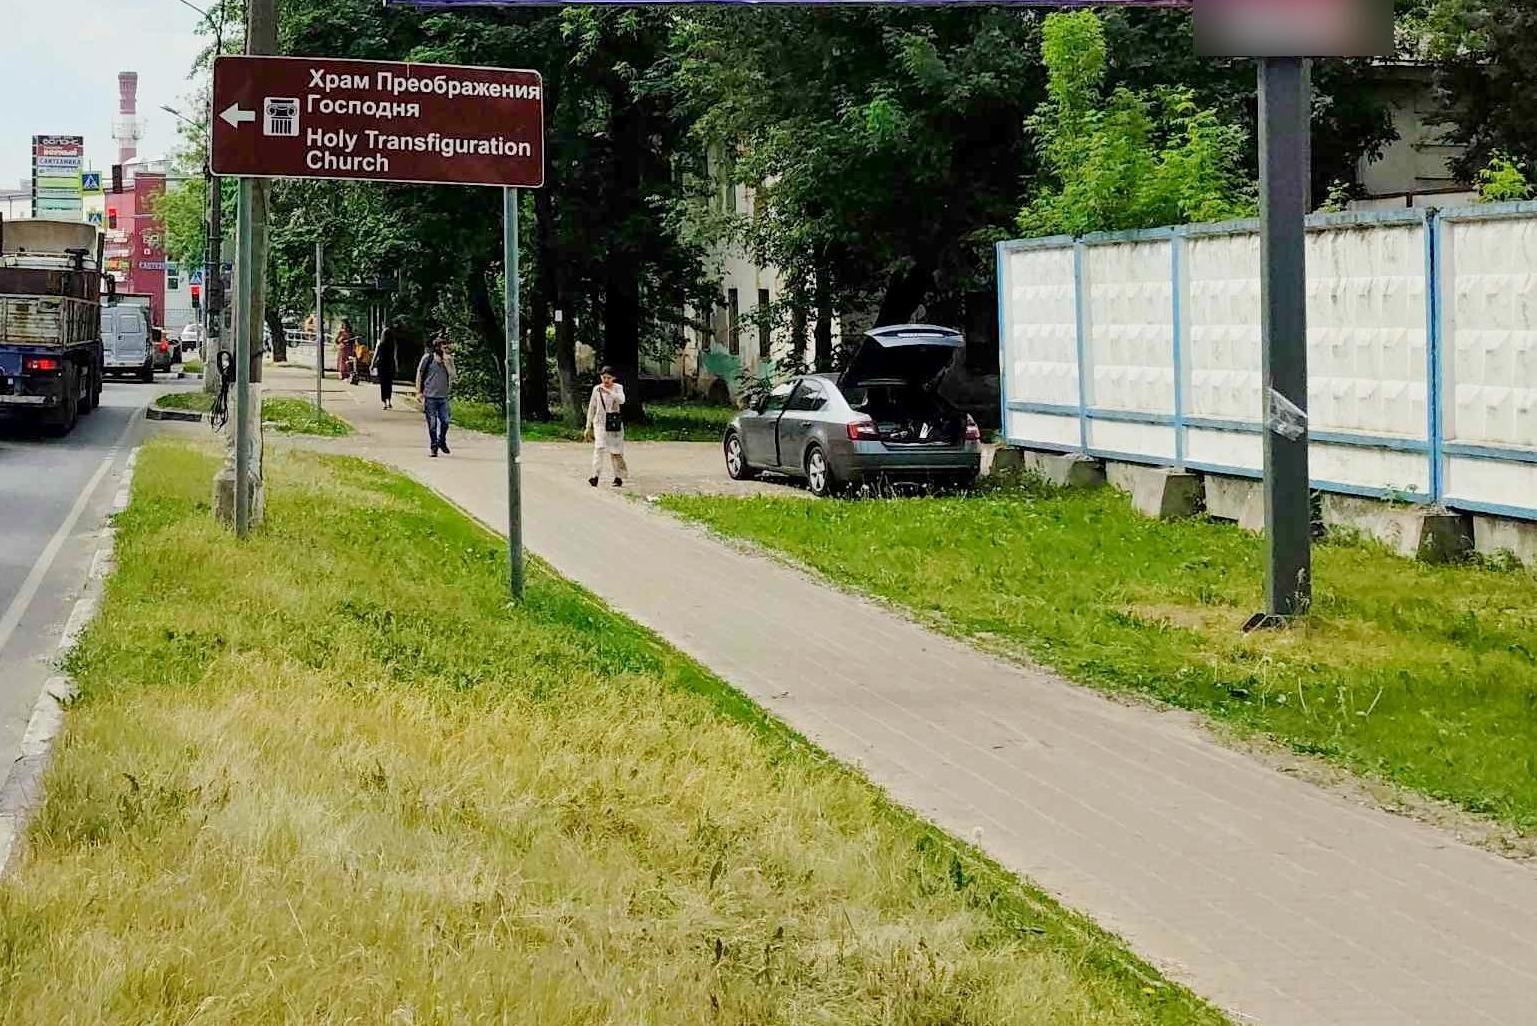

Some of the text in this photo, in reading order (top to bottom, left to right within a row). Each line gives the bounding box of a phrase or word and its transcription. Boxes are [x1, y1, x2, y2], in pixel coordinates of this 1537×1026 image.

[308, 68, 541, 100] Храм Преображения
[306, 94, 420, 118] Господня
[306, 128, 531, 157] Holy Transfiguration
[306, 151, 389, 172] Church
